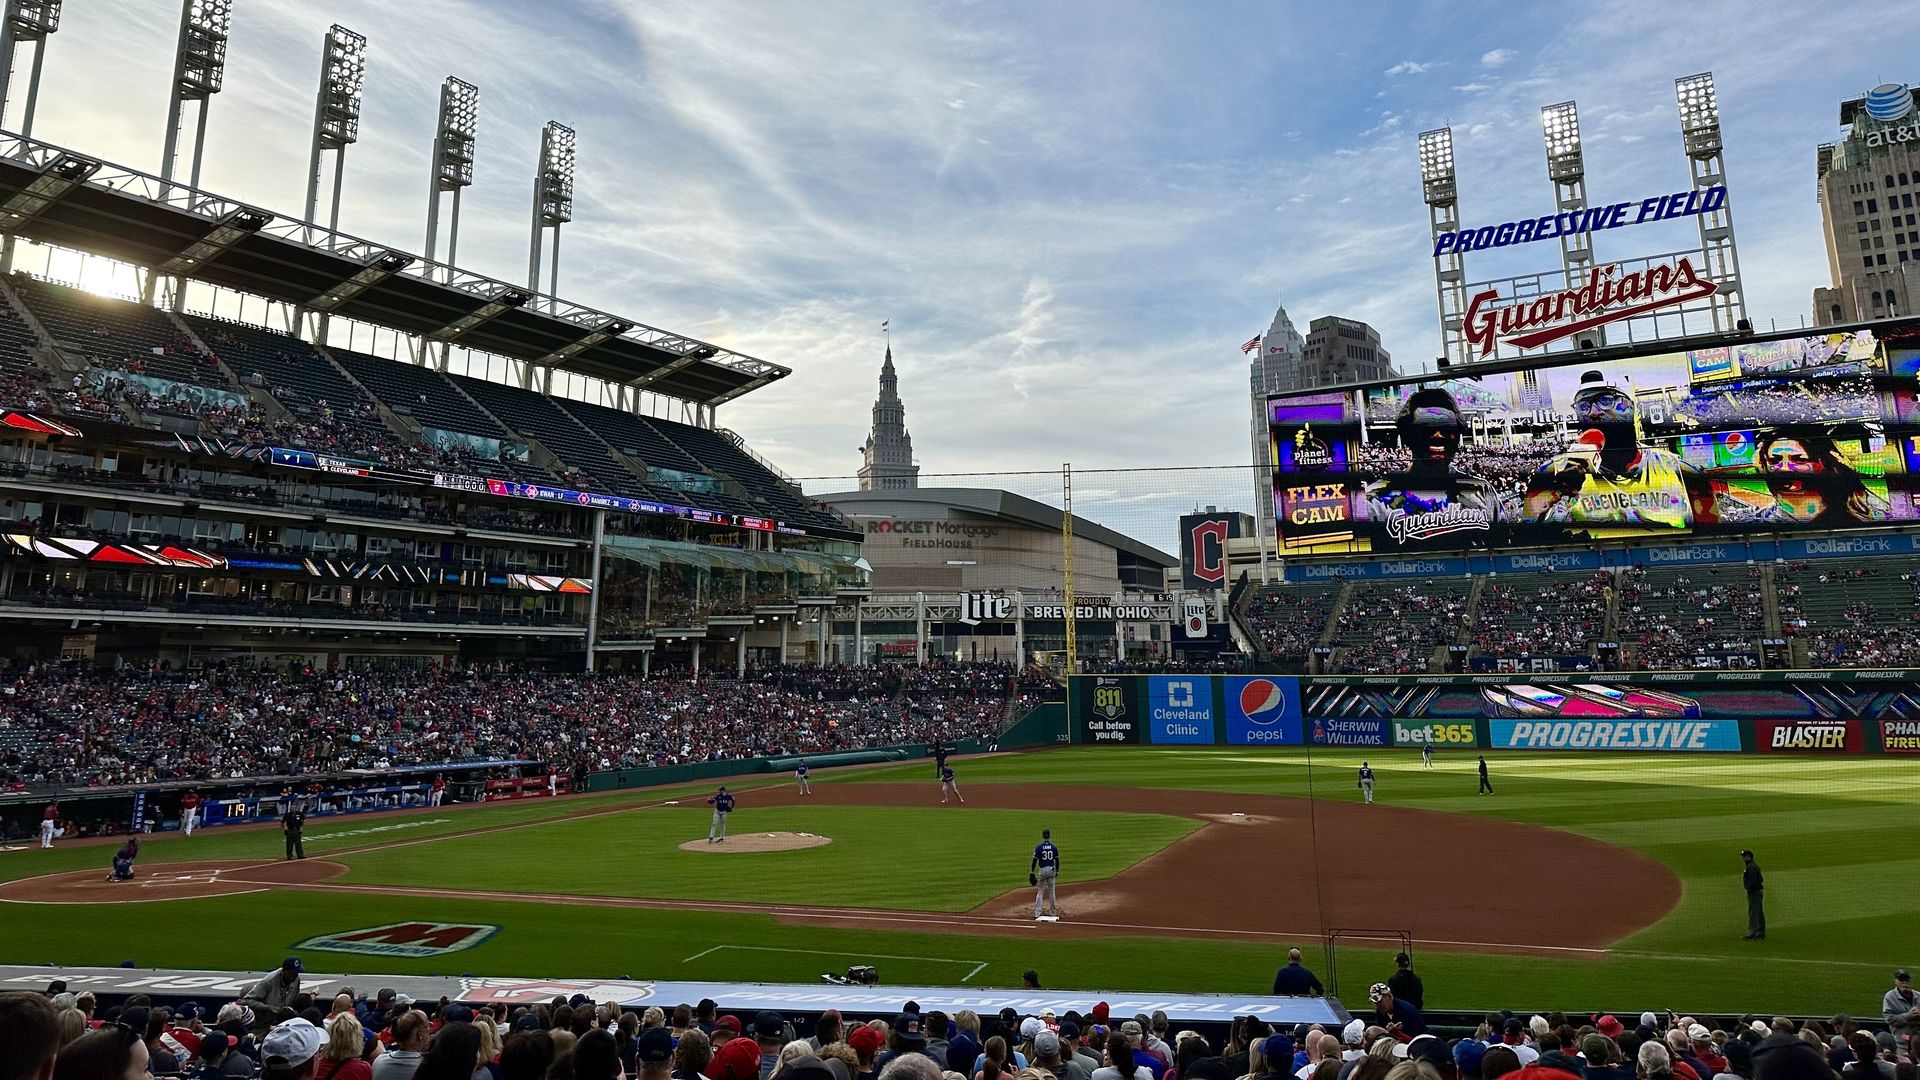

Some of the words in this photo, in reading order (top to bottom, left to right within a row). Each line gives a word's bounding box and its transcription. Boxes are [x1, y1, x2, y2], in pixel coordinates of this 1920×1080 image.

[1432, 202, 1631, 257] PROGRESSIVE
[1636, 185, 1727, 223] FIELD
[1462, 255, 1719, 359] Guardians
[296, 455, 300, 463] 1
[1294, 448, 1326, 460] planet
[1299, 456, 1333, 465] fitness
[330, 467, 358, 475] CLEVELAND
[1287, 483, 1345, 503] FLEX
[1582, 492, 1671, 512] CLEVELAND
[1291, 505, 1345, 524] CAM
[867, 521, 933, 533] ROCKET
[936, 521, 998, 538] Mortgage
[1386, 503, 1489, 544] Guardians
[1192, 520, 1228, 582] C
[1806, 538, 1891, 553] DollarBank
[1511, 553, 1581, 568] DollarBank
[1649, 547, 1726, 561] DollarBank
[1305, 565, 1366, 577] DollarBank
[1381, 561, 1445, 574] DollarBank
[958, 592, 1013, 625] Lite
[1073, 597, 1111, 605] PROUDLY
[1097, 606, 1111, 619] IN
[1116, 606, 1150, 619] OHIO
[1187, 605, 1204, 616] Lite
[1096, 688, 1120, 707] 811
[1154, 708, 1210, 720] Cleveland
[1089, 721, 1103, 730] Call
[1105, 721, 1131, 730] before
[1166, 723, 1199, 735] Clinic
[1327, 719, 1380, 732] SHERWIN
[1096, 732, 1110, 740] you
[1111, 731, 1125, 740] dig.
[1247, 728, 1283, 743] pepsi
[1327, 732, 1383, 745] WILLIAMS.
[1395, 723, 1474, 744] bet365
[1509, 722, 1711, 748] PROGRESSIVE
[1771, 726, 1846, 748] BLASTER
[1042, 850, 1053, 860] 30
[331, 923, 483, 948] M
[710, 991, 1100, 1008] PROGRESSIVE
[1110, 1001, 1281, 1014] FIELD
